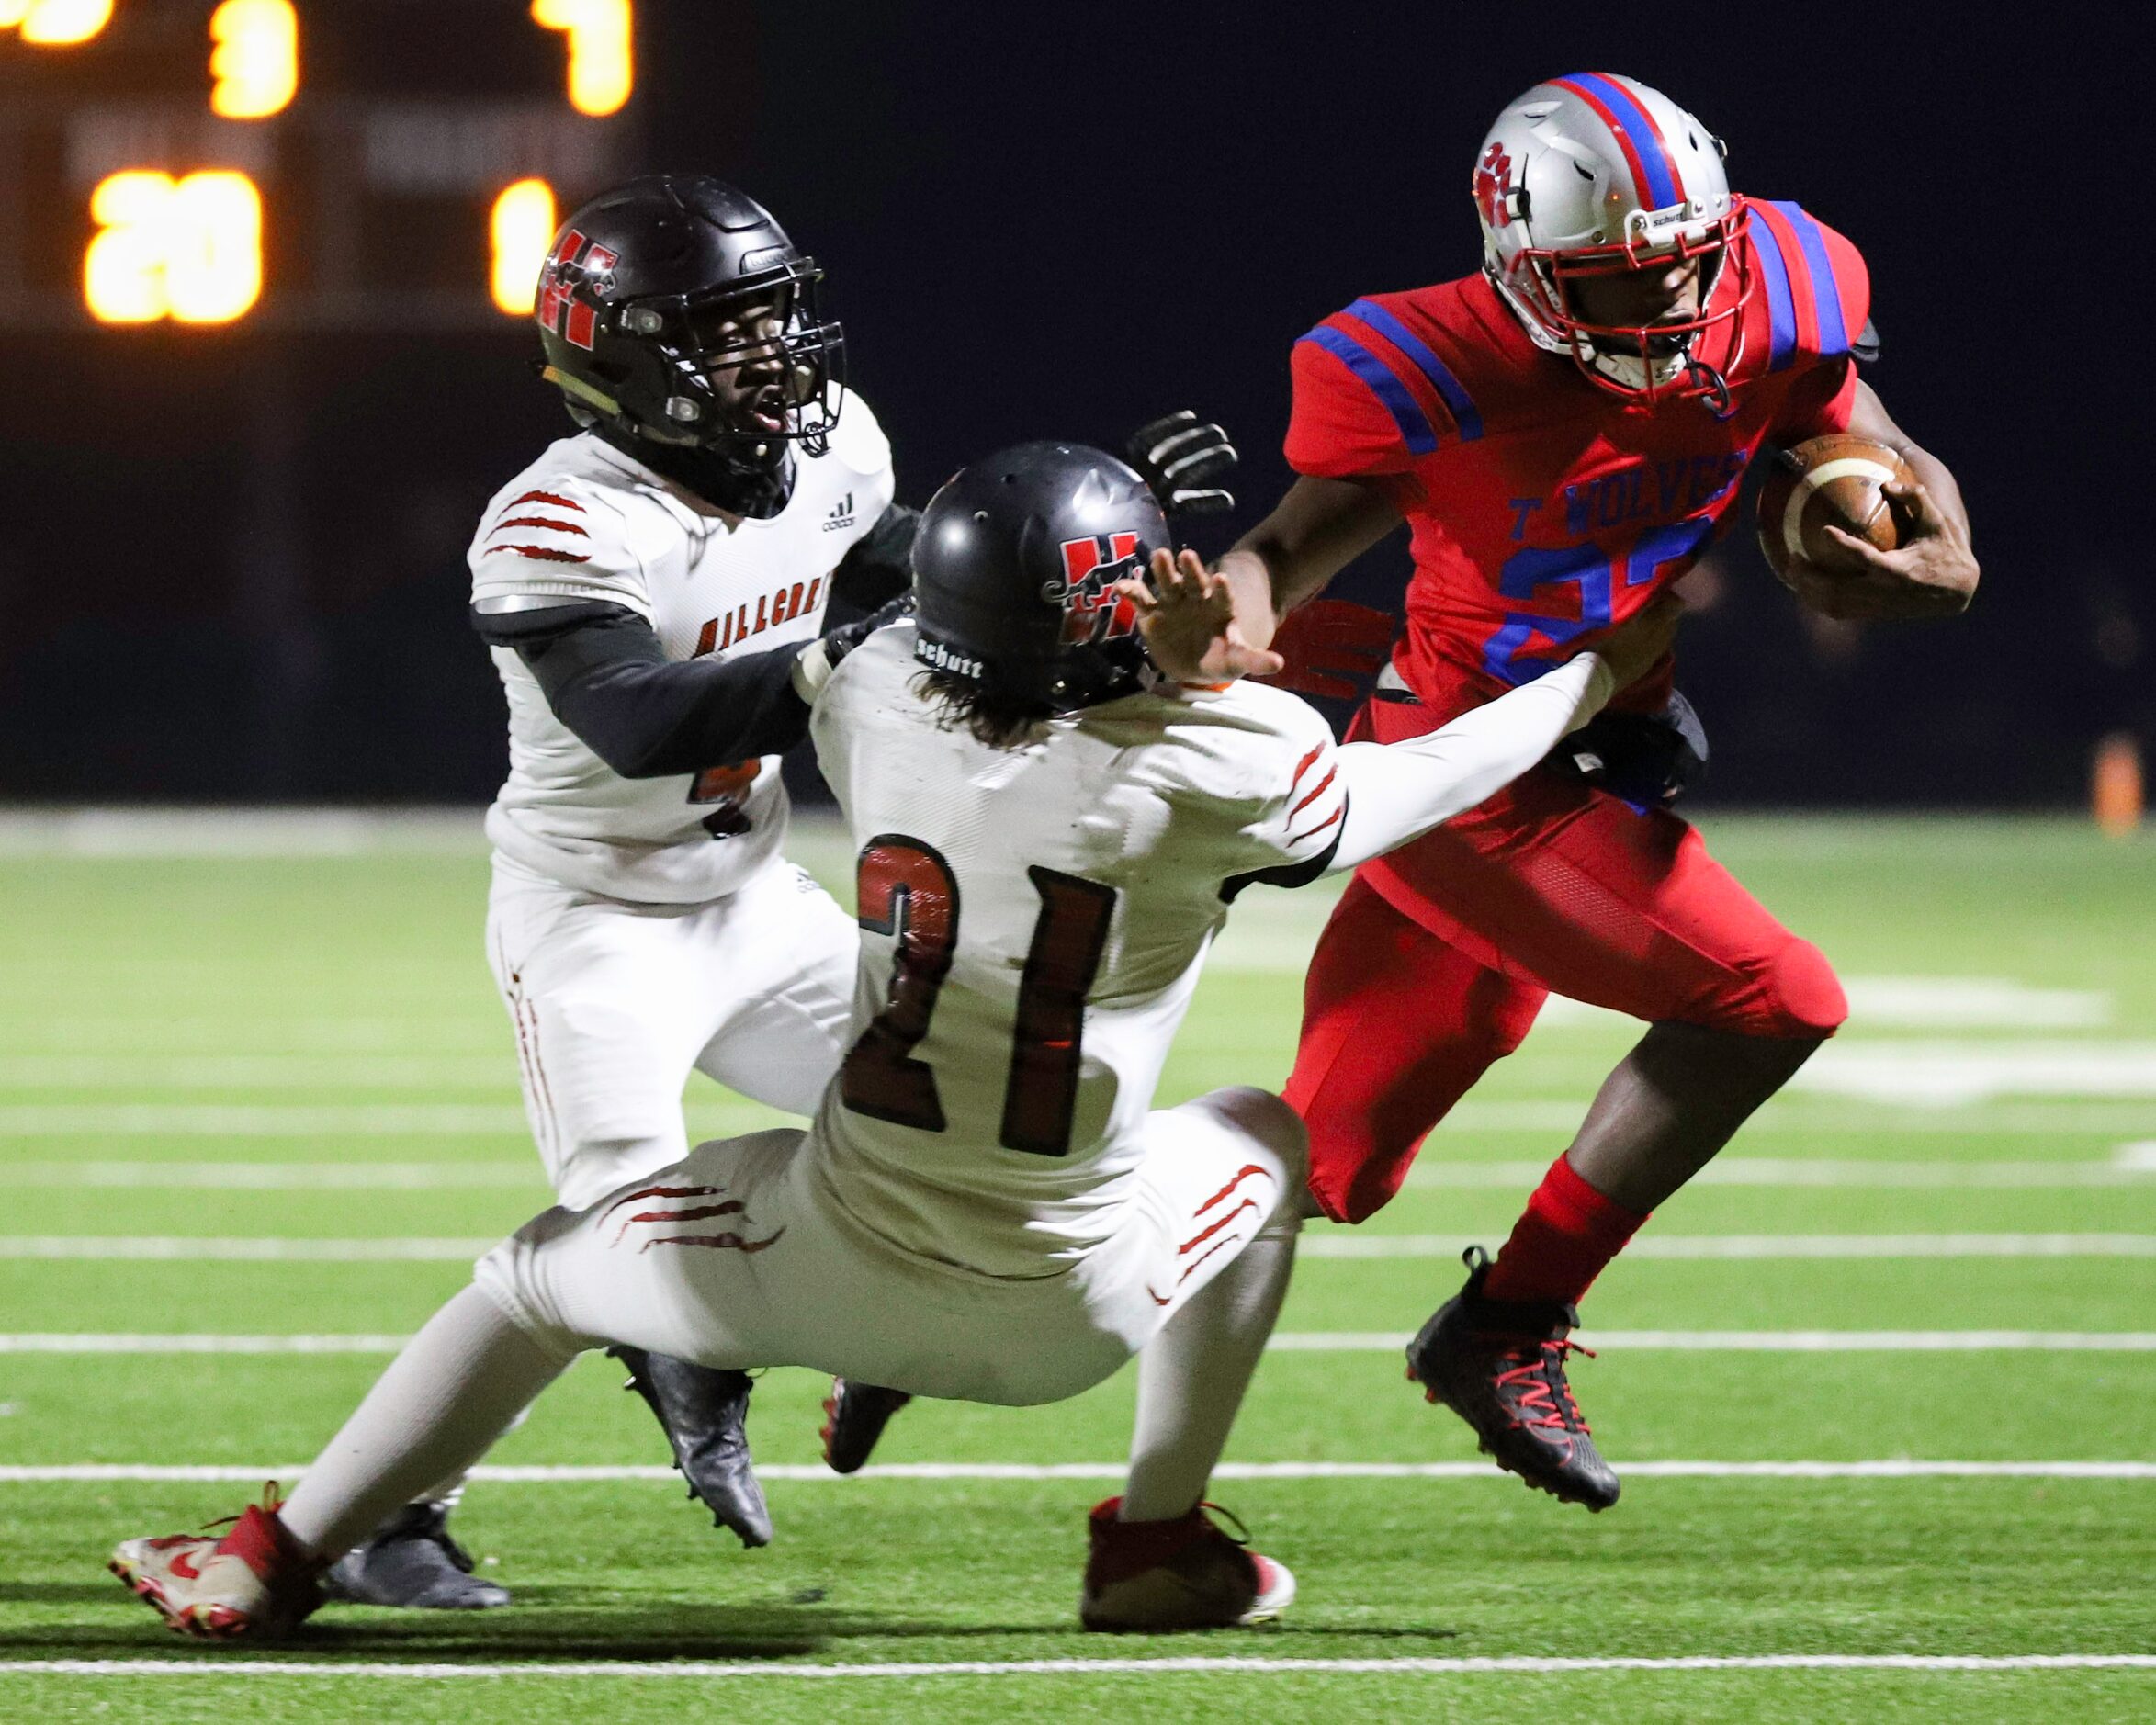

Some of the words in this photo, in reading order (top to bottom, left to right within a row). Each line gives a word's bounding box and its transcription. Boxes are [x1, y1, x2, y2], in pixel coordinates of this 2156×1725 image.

[1509, 499, 1542, 541] T
[691, 576, 831, 660] HILLCRE
[918, 639, 982, 678] schutt
[841, 833, 1117, 1157] 21
